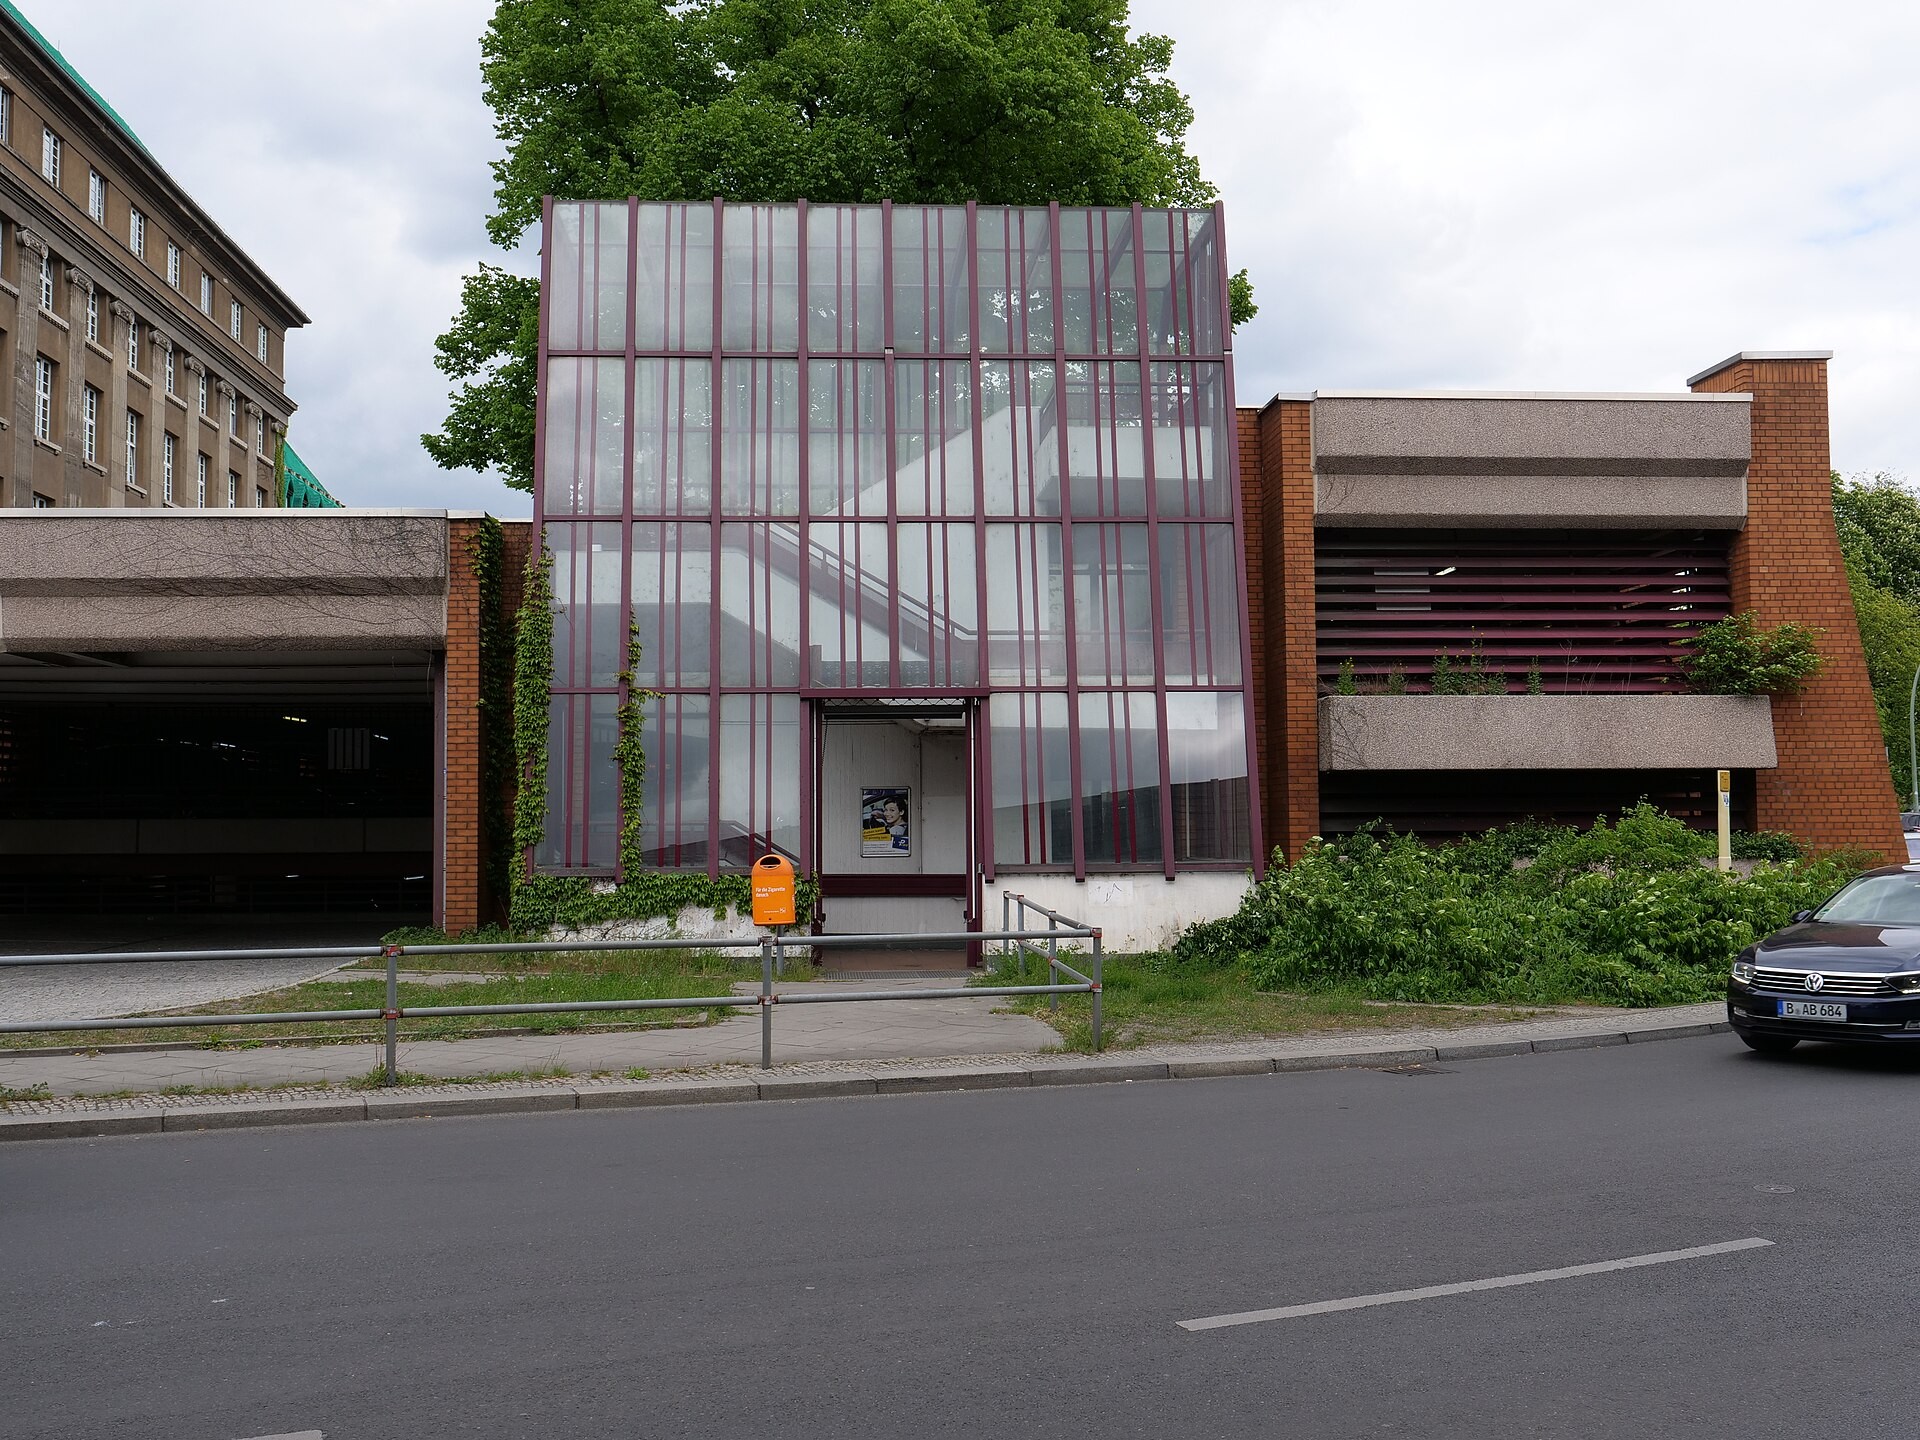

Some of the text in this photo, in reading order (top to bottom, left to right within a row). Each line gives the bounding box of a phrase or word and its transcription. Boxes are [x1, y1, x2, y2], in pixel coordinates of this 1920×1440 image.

[1786, 1002, 1842, 1017] B AB 684
